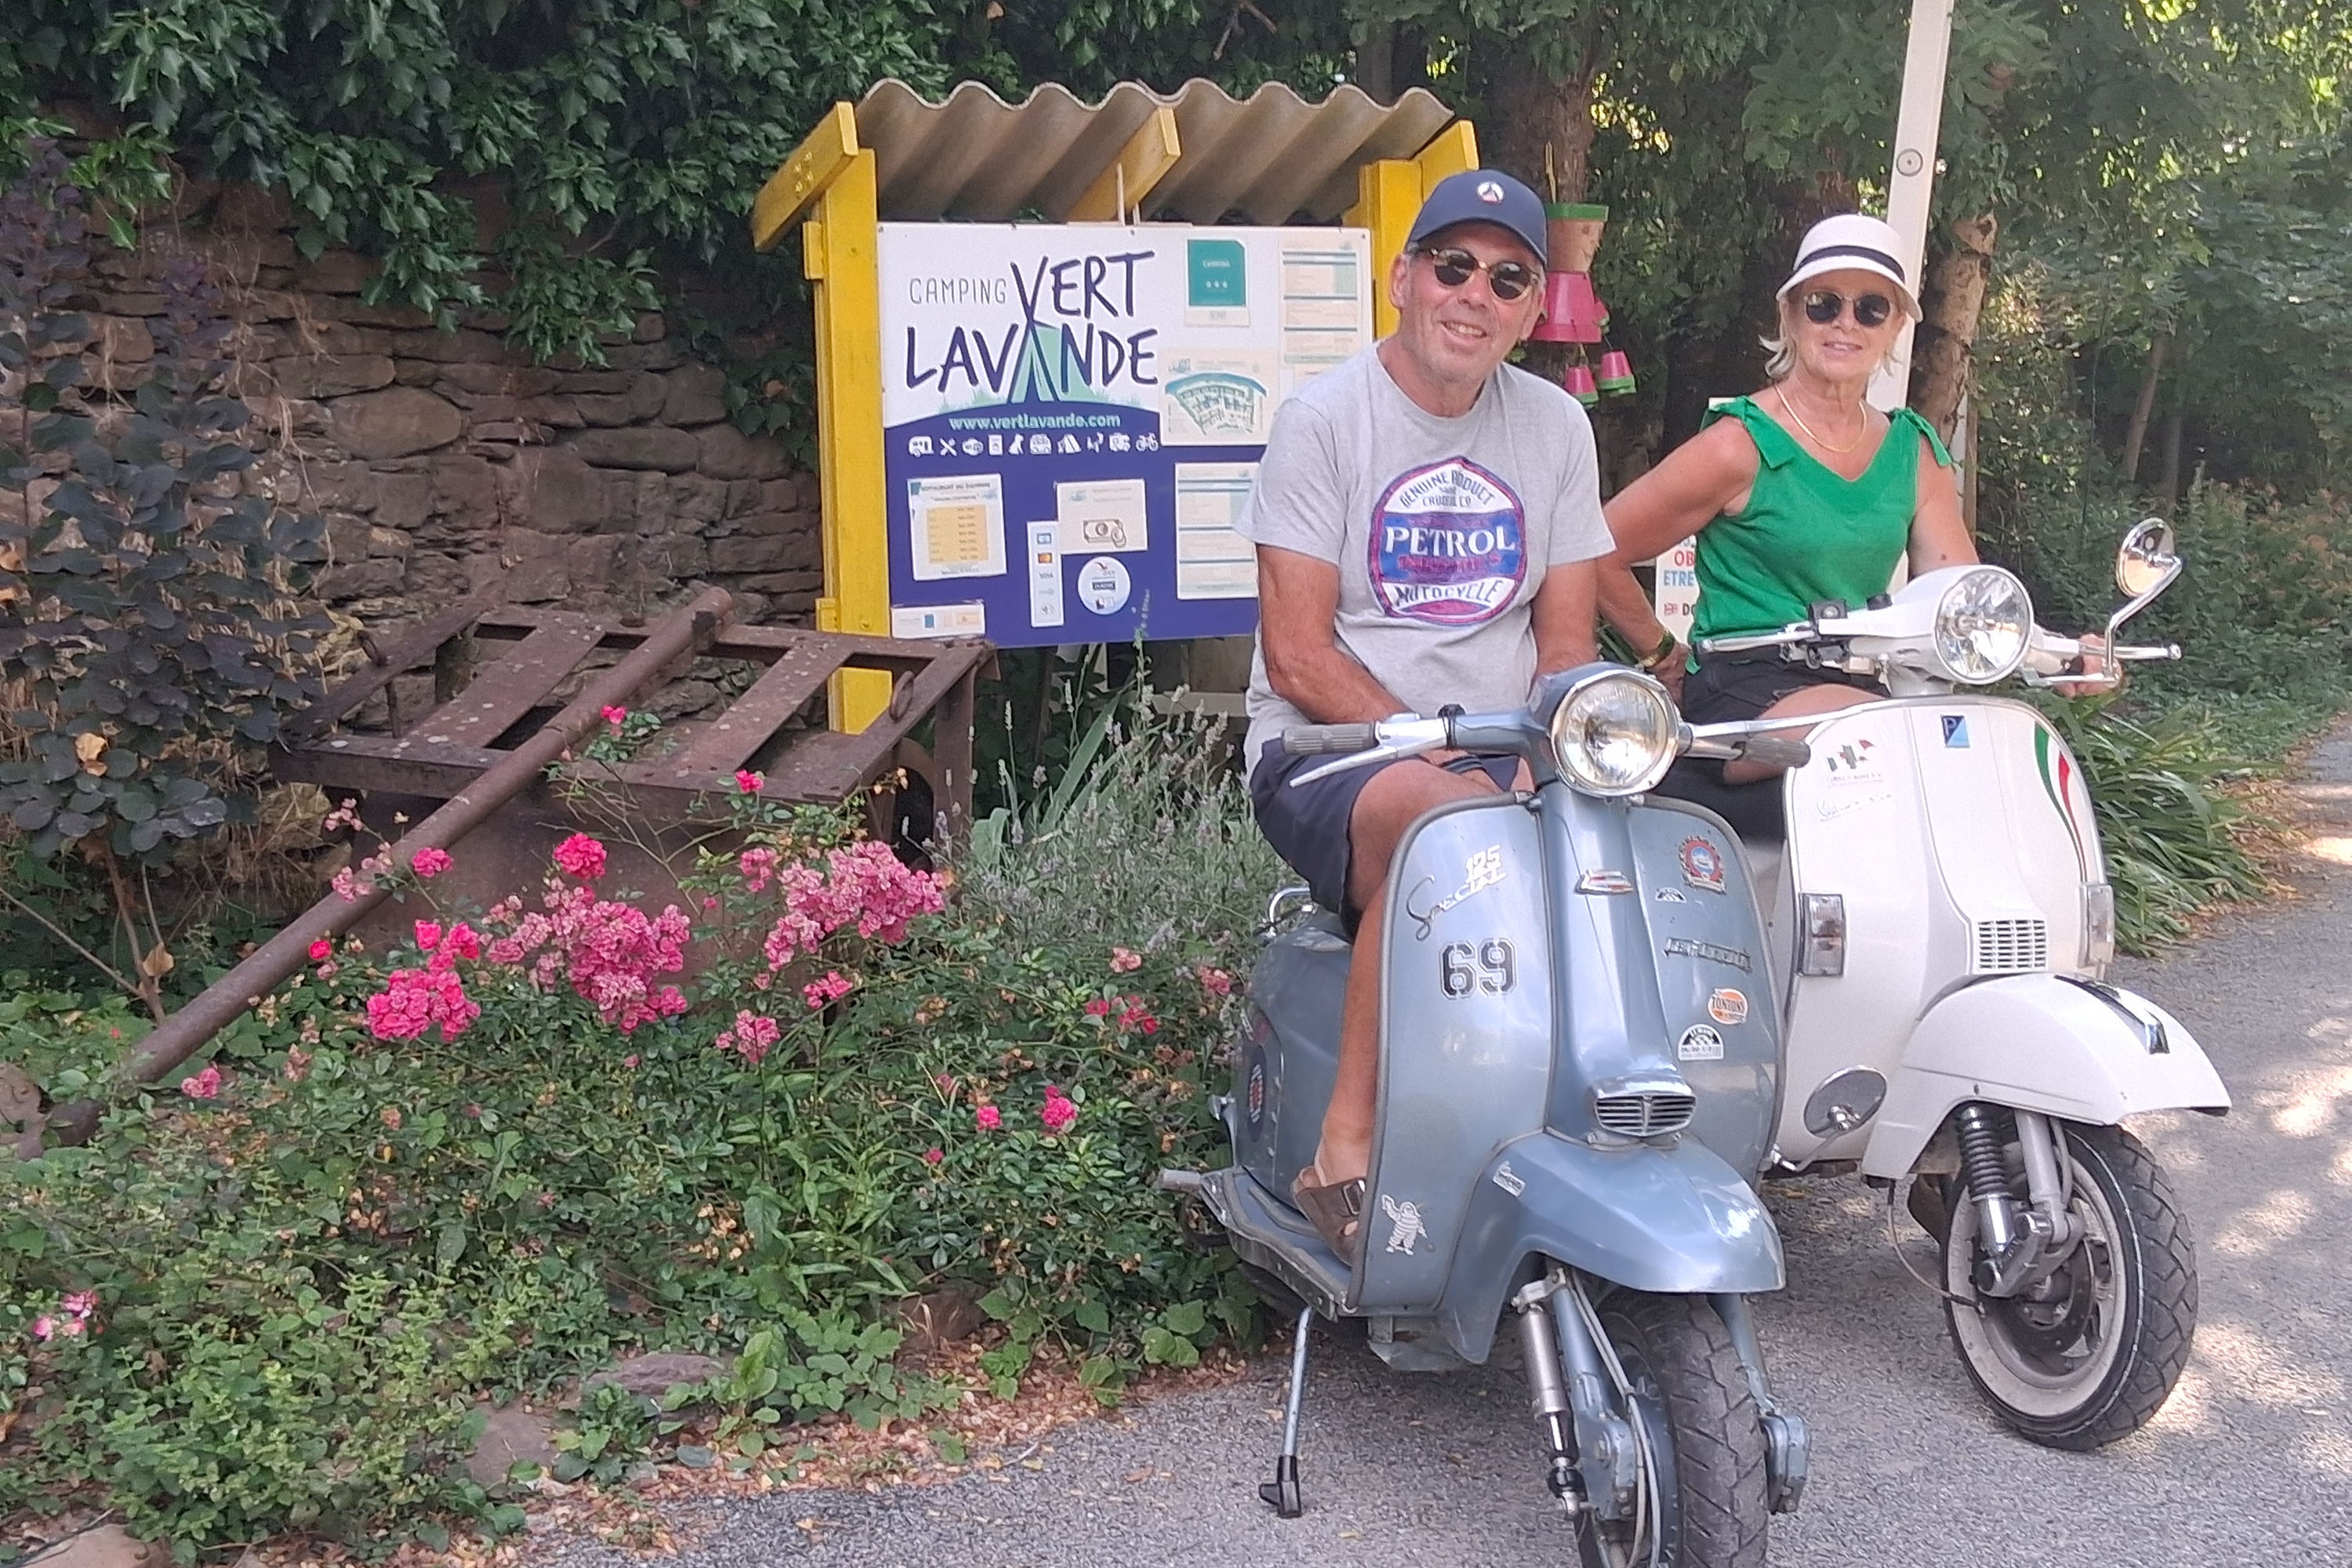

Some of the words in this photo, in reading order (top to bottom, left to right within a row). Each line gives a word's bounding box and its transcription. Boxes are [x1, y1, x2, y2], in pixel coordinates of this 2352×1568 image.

[909, 278, 1007, 305] CAMPING
[1010, 250, 1156, 321] VERT
[906, 320, 1159, 405] LAVANDE
[948, 413, 1121, 430] www.vertlavande.com
[1399, 471, 1450, 507] GENUINE
[1385, 525, 1515, 557] PETROL
[1439, 937, 1518, 1001] 69
